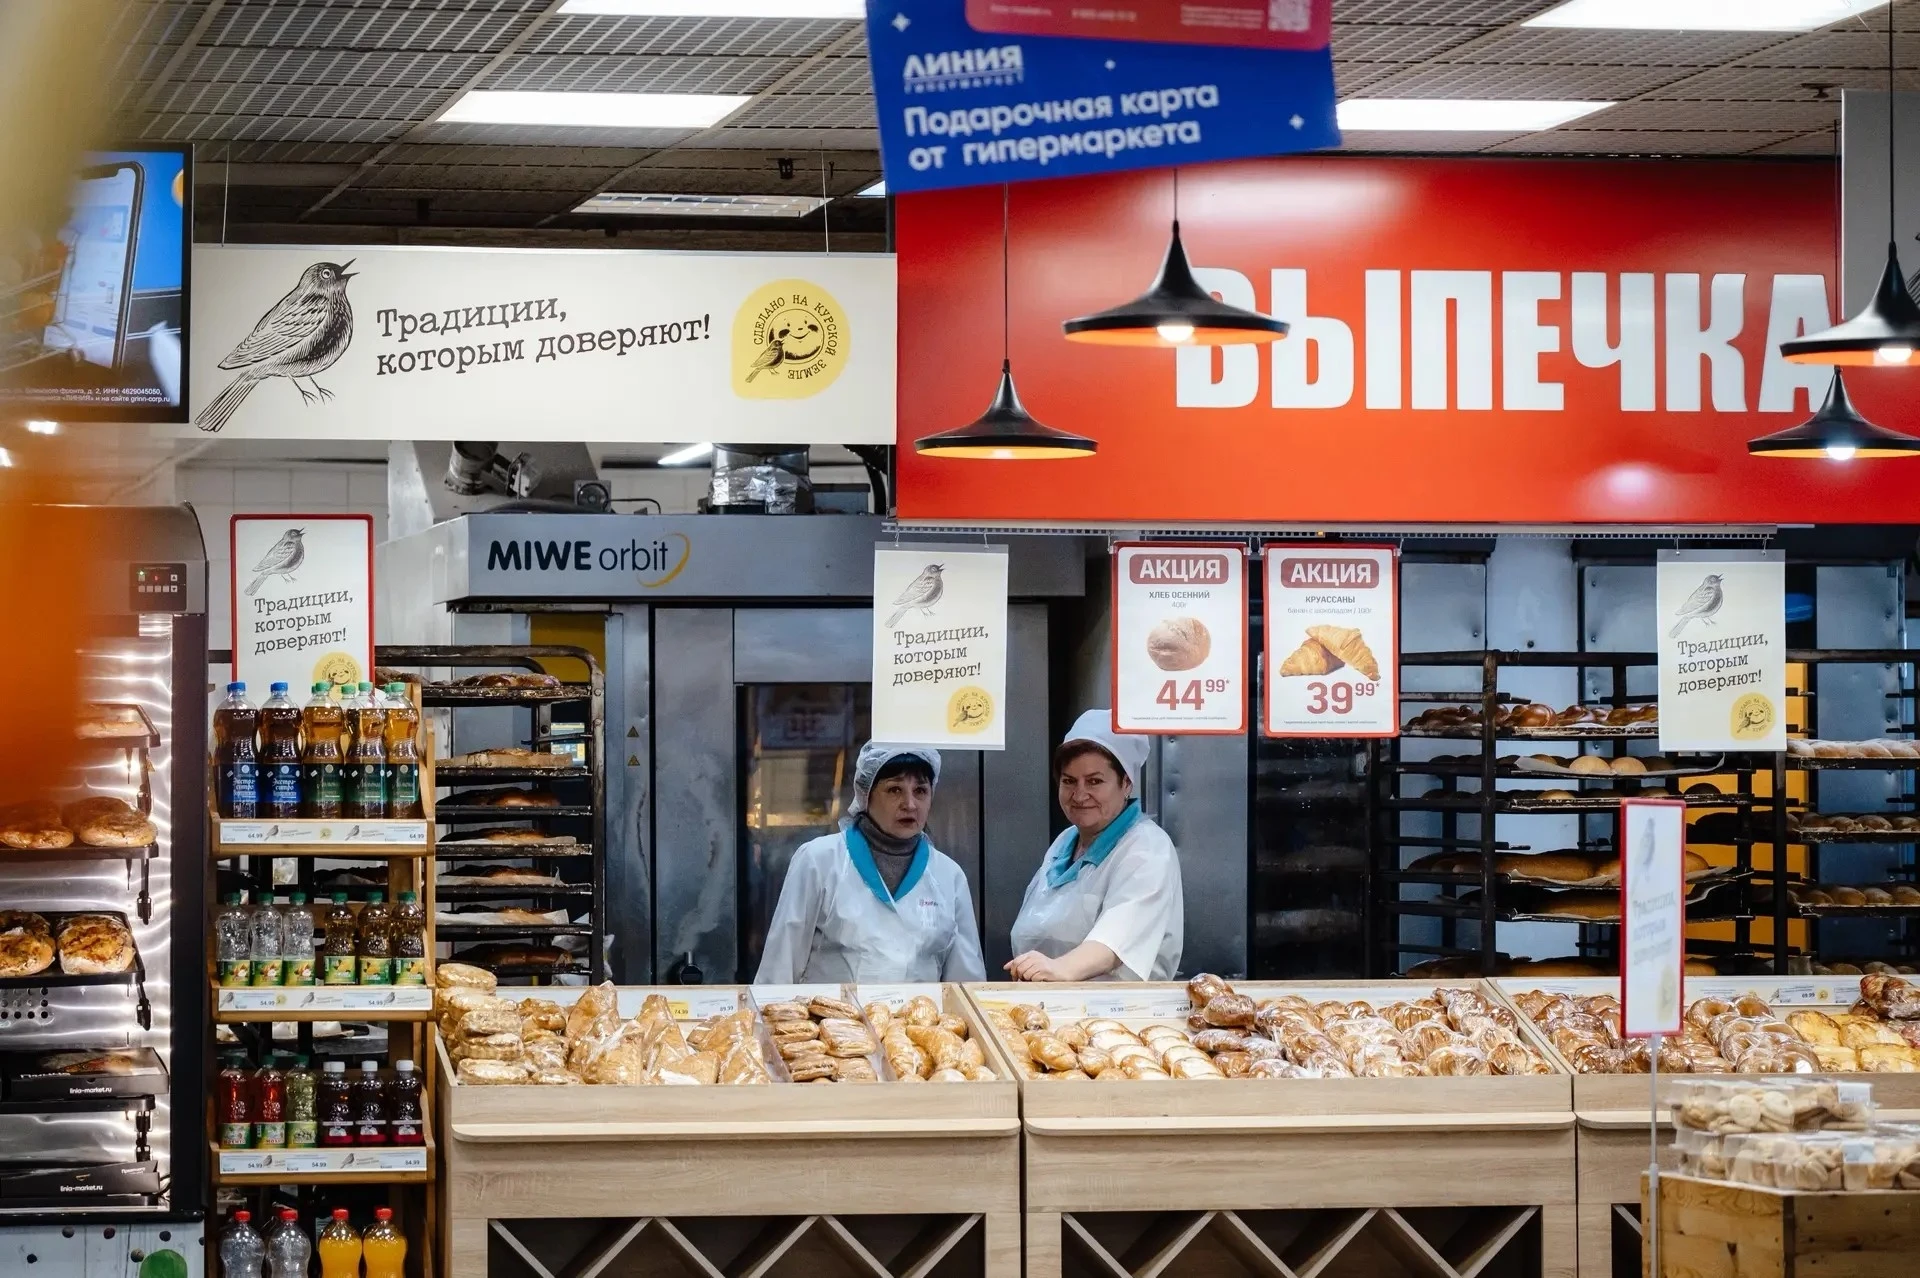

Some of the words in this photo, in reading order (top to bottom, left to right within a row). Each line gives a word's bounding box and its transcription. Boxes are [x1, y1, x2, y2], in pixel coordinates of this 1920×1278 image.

[903, 45, 1023, 79] ЛИНИЯ
[904, 94, 1112, 137] Подарочная
[1121, 84, 1220, 120] карта
[908, 144, 946, 171] от
[962, 121, 1201, 166] гипермаркета
[792, 294, 808, 306] НА
[376, 298, 567, 343] Традиции,
[754, 297, 785, 345] СДЕЛАНО
[814, 302, 838, 356] КУРСКОЙ
[376, 339, 525, 376] которым
[535, 314, 711, 363] доверяют!
[1176, 268, 1838, 413] ВЫПЕЧКА
[788, 359, 827, 380] ЗЕМЛЕ
[487, 540, 592, 571] MIWE
[598, 538, 669, 571] orbit
[1139, 559, 1221, 583] АКЦИЯ
[1290, 563, 1371, 586] АКЦИЯ
[254, 589, 353, 616] Традиции,
[1149, 591, 1170, 599] ХЛЕБ
[1171, 589, 1210, 599] ОСЕННИЙ
[1305, 595, 1356, 604] КРУАССАНЫ
[254, 612, 332, 634] которым
[254, 628, 347, 656] доверяют!
[893, 626, 989, 649] Традиции,
[1677, 633, 1769, 658] Традиции,
[893, 647, 968, 665] которым
[1677, 654, 1749, 674] которым
[892, 662, 981, 687] доверяют!
[1677, 669, 1762, 696] доверяют!
[1156, 679, 1205, 711] 44
[1306, 681, 1353, 715] 39
